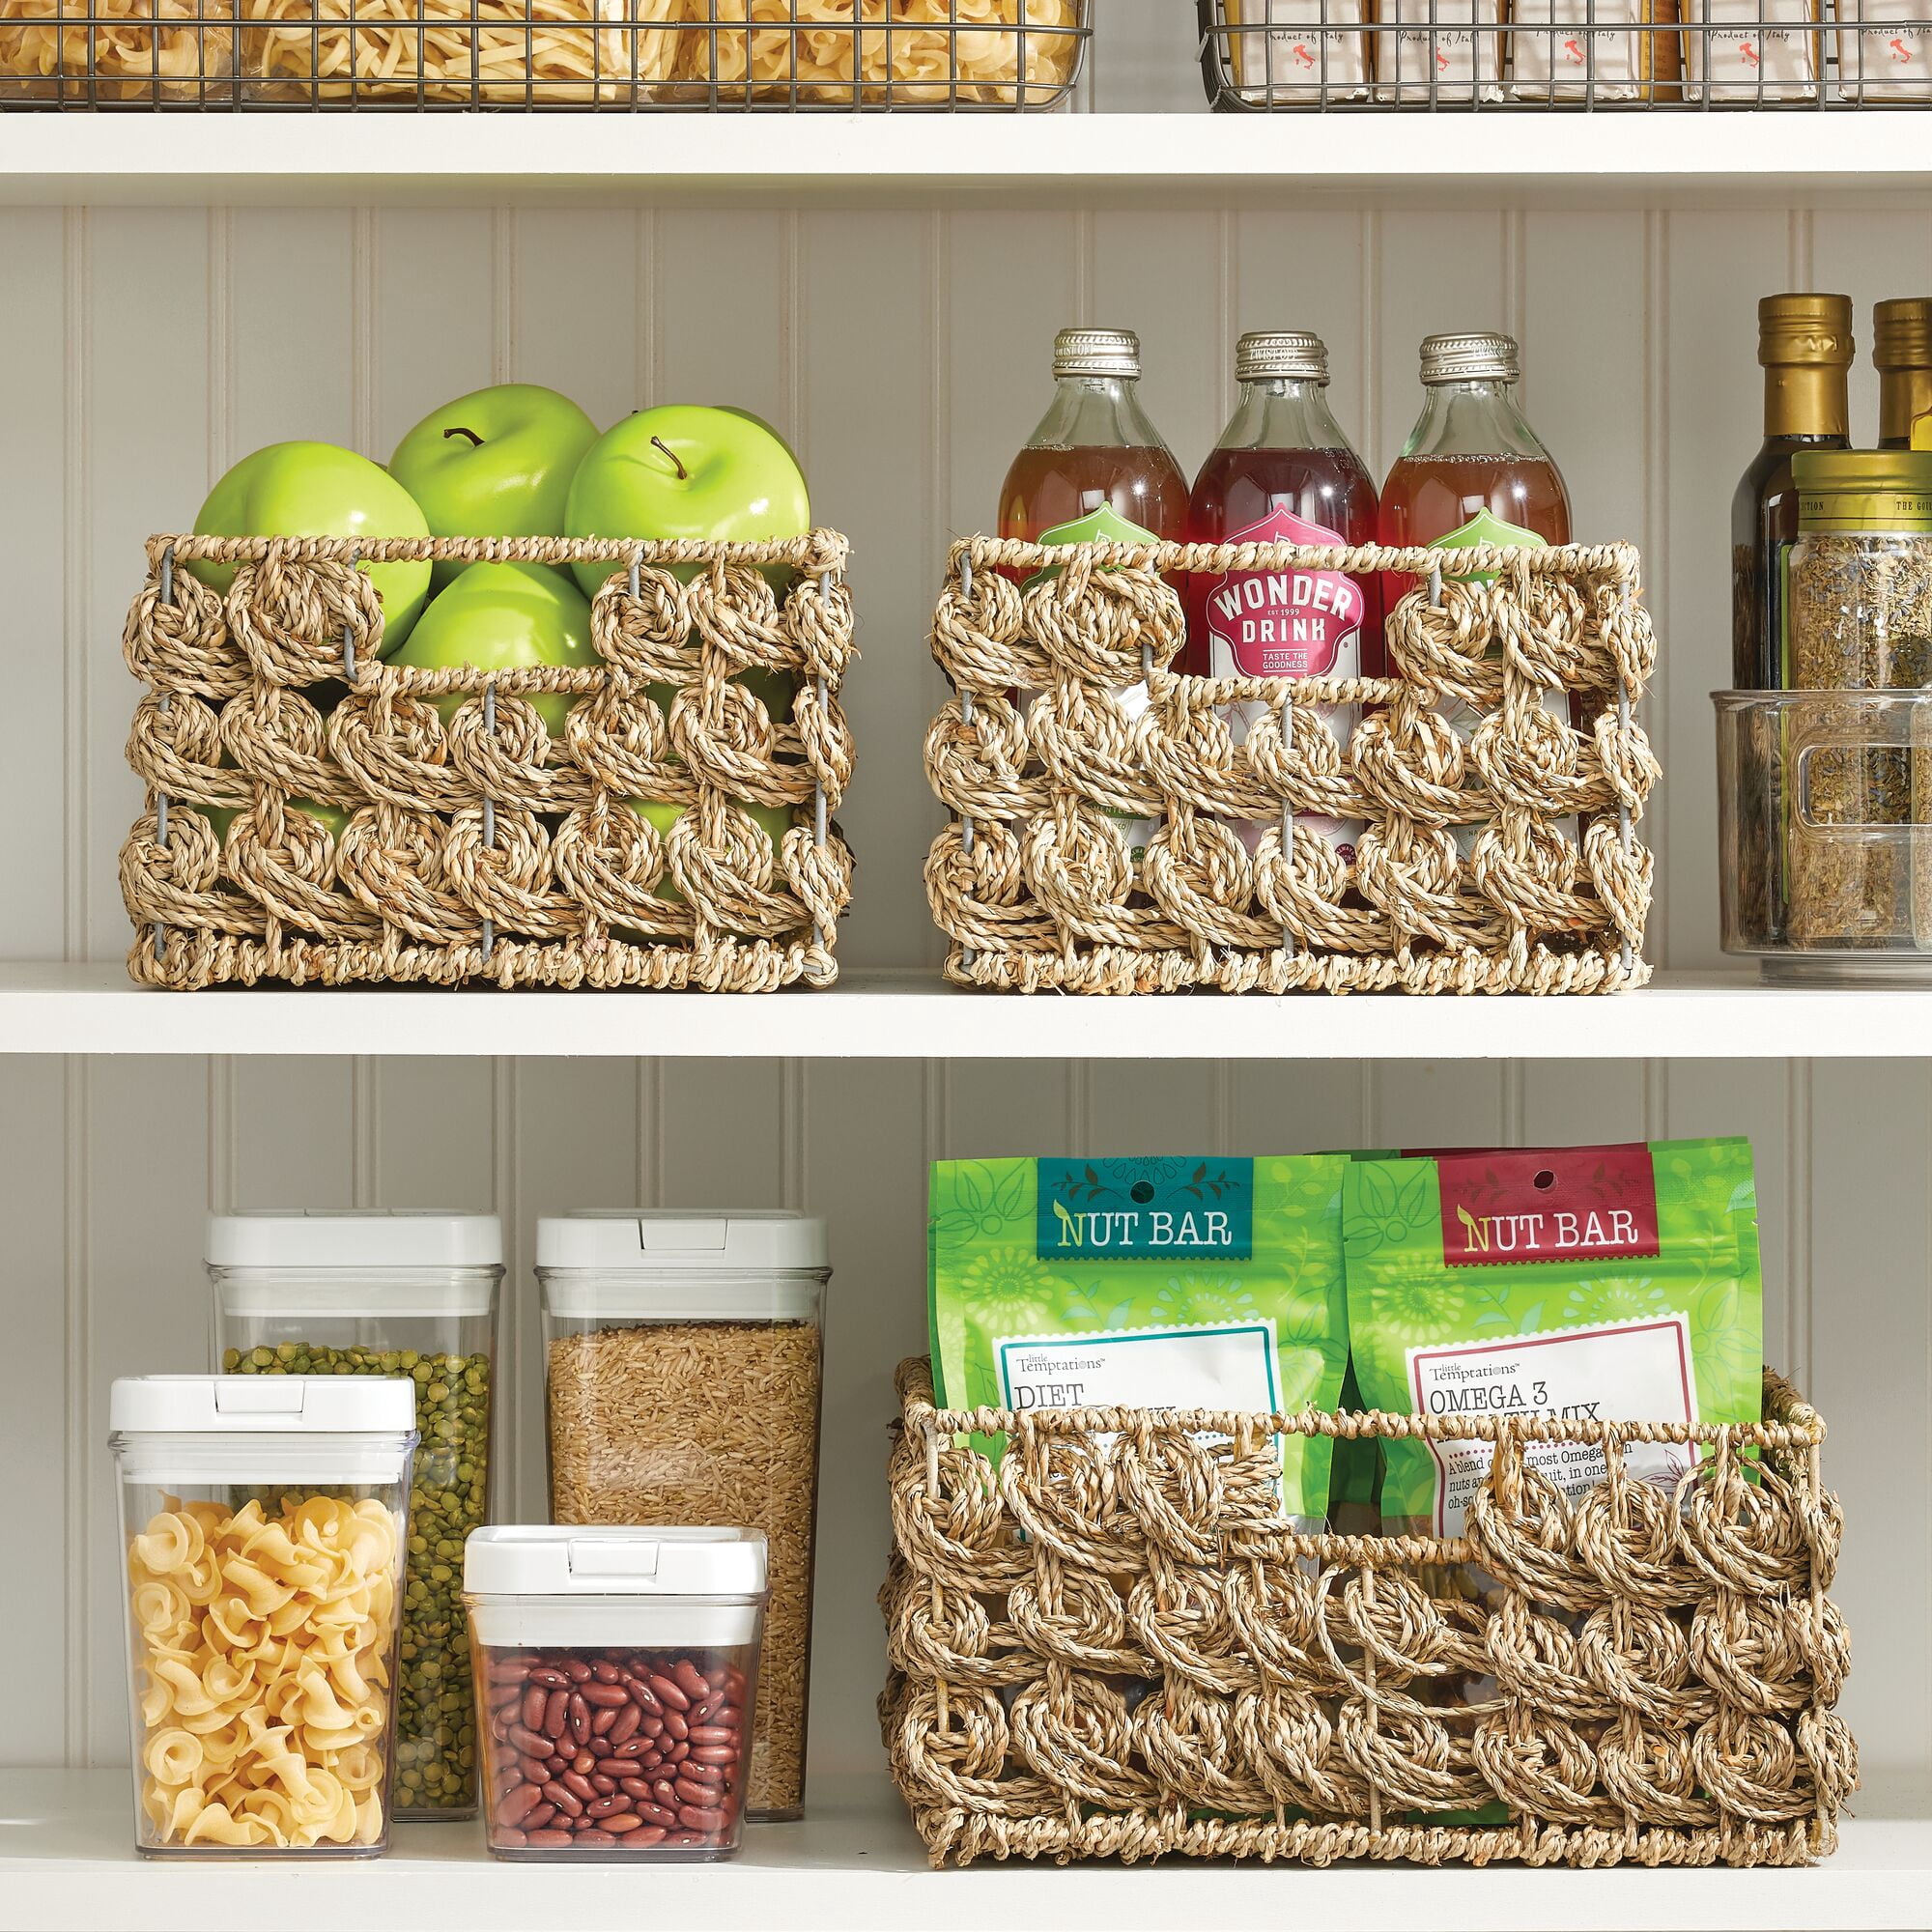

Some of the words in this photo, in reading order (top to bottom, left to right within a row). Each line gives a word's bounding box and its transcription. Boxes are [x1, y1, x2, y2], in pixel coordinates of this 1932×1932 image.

[1268, 31, 1302, 42] roduct
[1895, 500, 1913, 511] THE
[1213, 574, 1353, 622] WONDER
[1280, 608, 1300, 616] 1999
[1242, 618, 1325, 643] DRINK
[1263, 652, 1290, 661] TASTE
[1293, 652, 1308, 661] THE
[1263, 660, 1308, 669] GOODNESS
[1054, 1200, 1139, 1247] NUT
[1149, 1210, 1233, 1246] BAR
[1458, 1205, 1544, 1252] NUT
[1553, 1209, 1638, 1248] BAR
[1029, 1353, 1048, 1363] little
[1442, 1362, 1462, 1372] little
[1014, 1383, 1085, 1410] DIET
[1430, 1384, 1527, 1414] OMEGA
[1533, 1380, 1548, 1406] 3
[1449, 1462, 1457, 1475] A
[1455, 1457, 1485, 1473] blend
[1527, 1453, 1559, 1467] most
[1449, 1478, 1470, 1492] nuts
[1569, 1466, 1582, 1480] in
[1584, 1463, 1607, 1477] one
